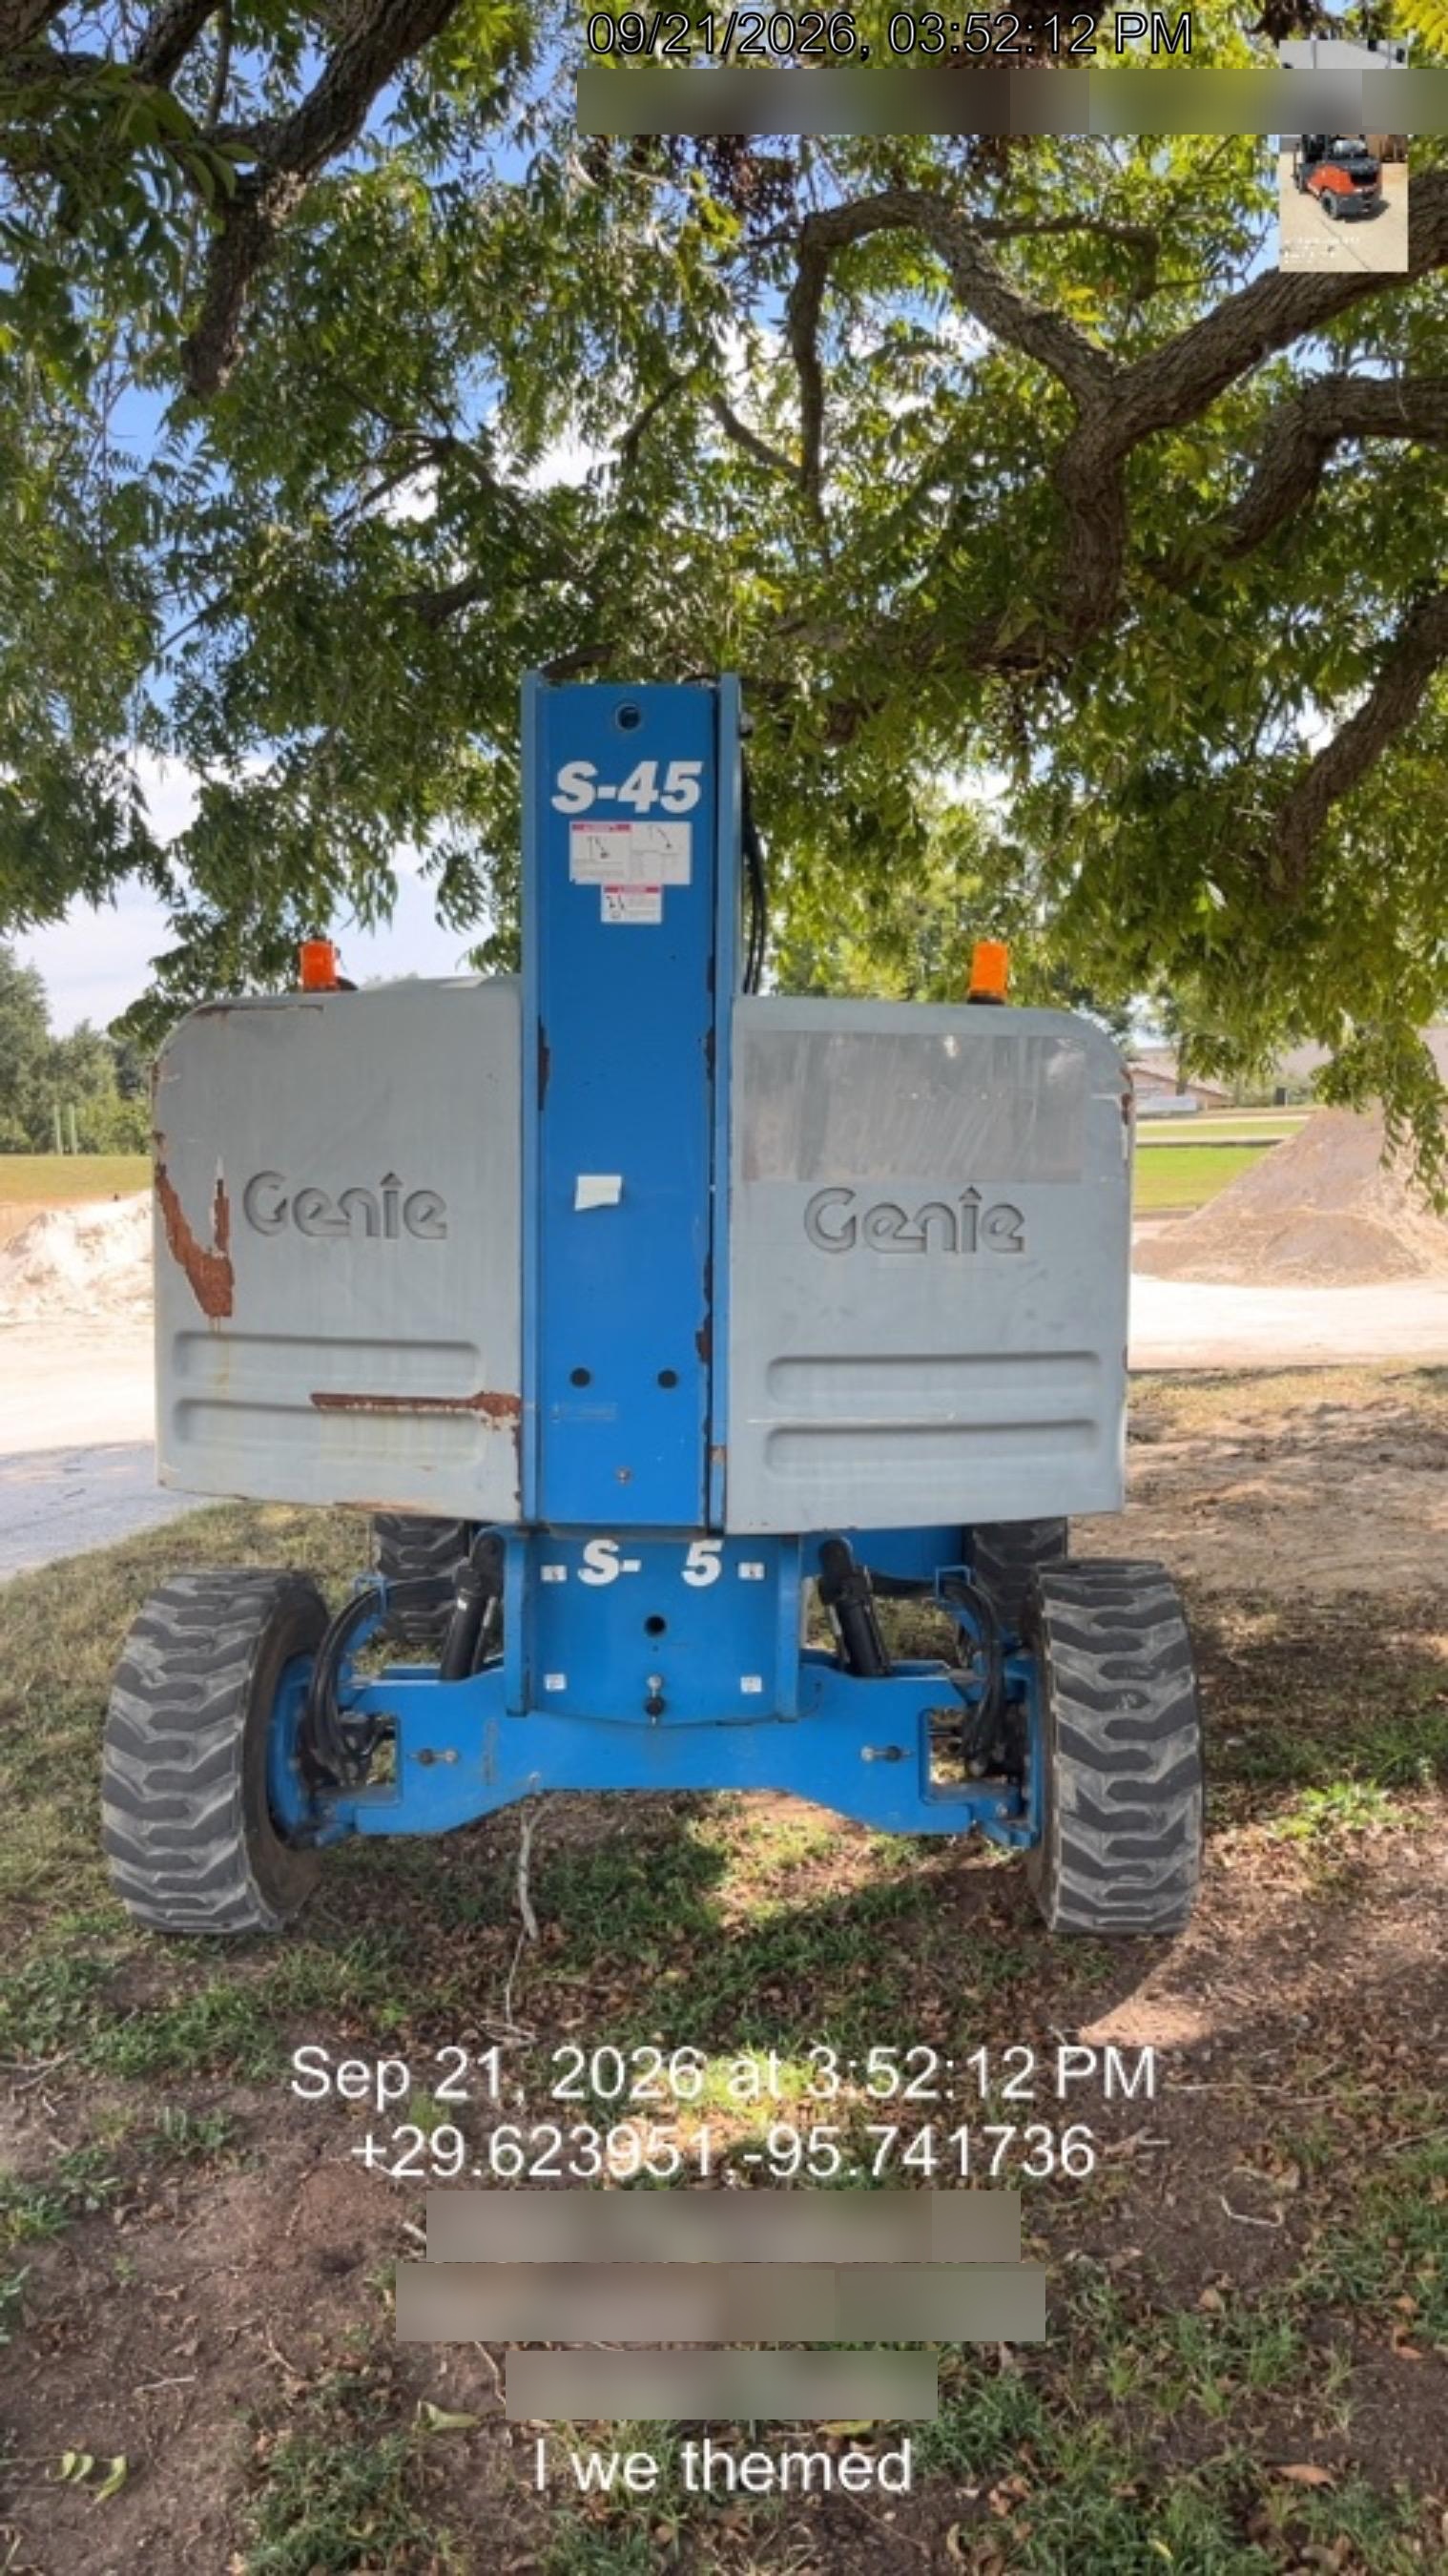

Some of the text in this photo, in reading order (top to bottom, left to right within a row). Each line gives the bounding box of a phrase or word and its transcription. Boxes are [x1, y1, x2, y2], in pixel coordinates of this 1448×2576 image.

[551, 761, 703, 813] S-45
[243, 1170, 449, 1240] Genie
[804, 1185, 1025, 1255] Genie
